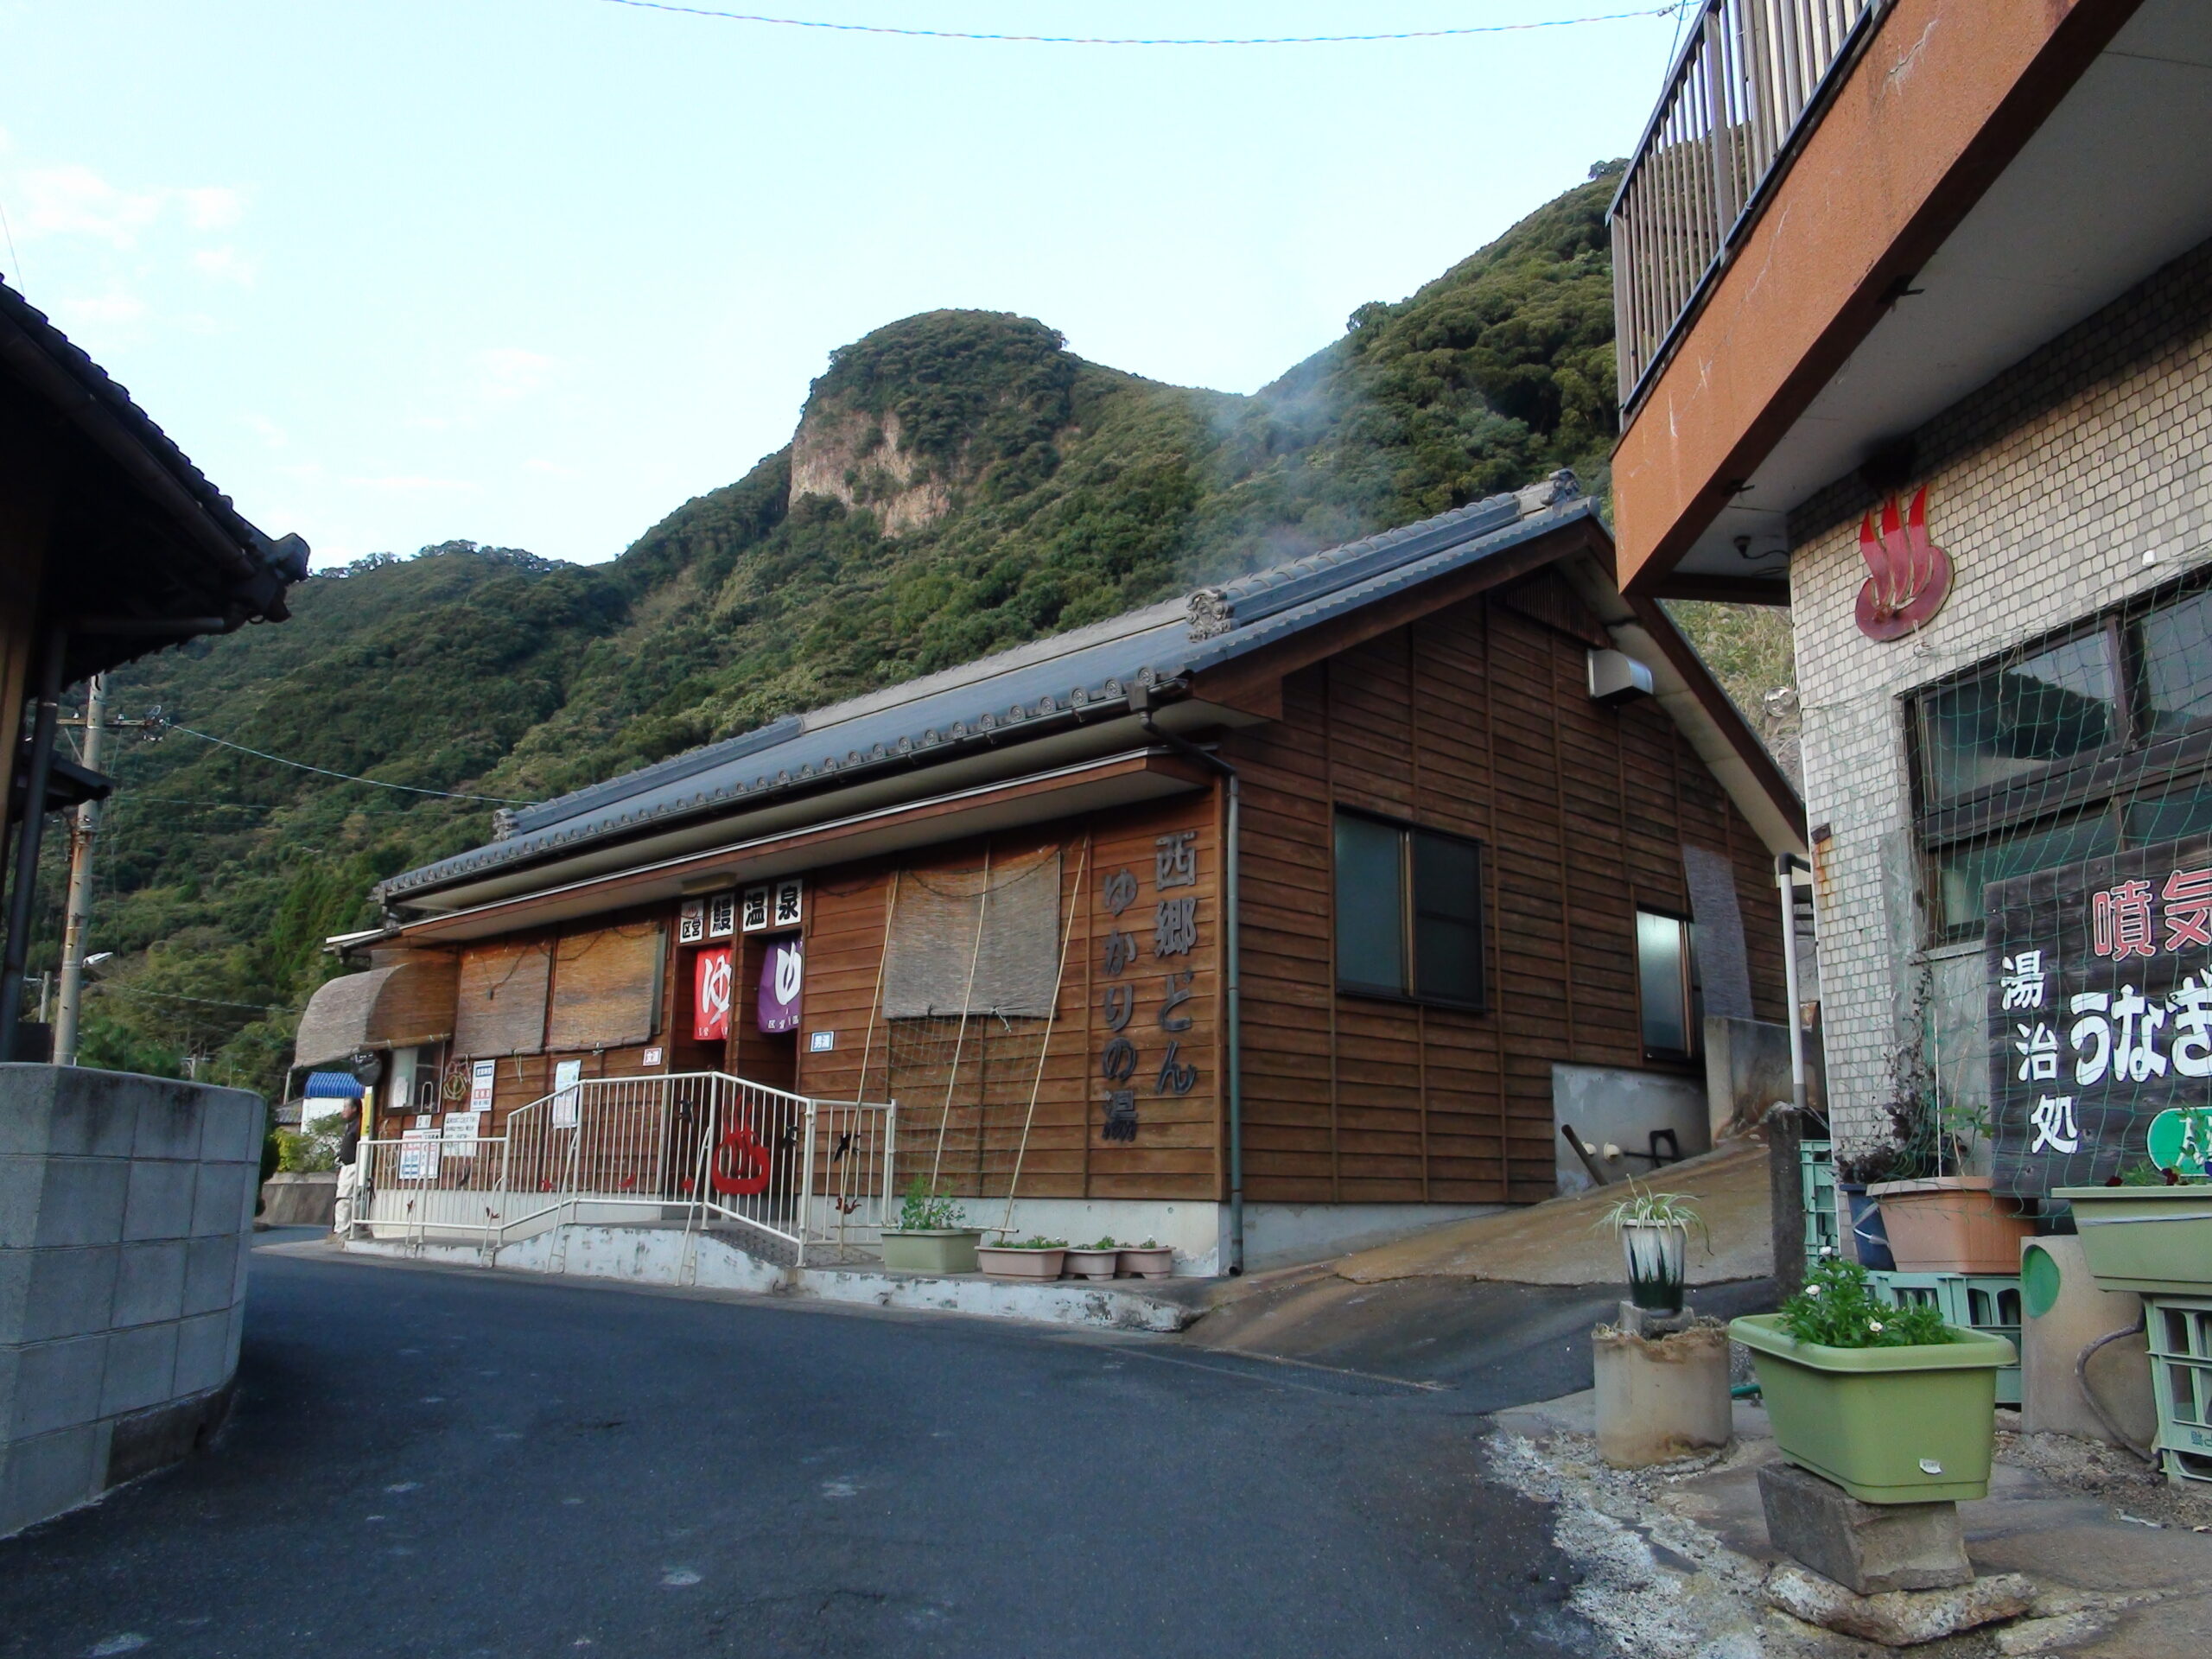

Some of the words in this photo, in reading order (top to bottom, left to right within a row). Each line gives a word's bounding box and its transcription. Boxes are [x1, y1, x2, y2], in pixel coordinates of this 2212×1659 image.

[702, 955, 732, 1025] ゆ
[1103, 868, 1138, 1141] ゆかりの湯
[1155, 831, 1198, 1095] 西郷どん
[2000, 950, 2078, 1154] 湯治処
